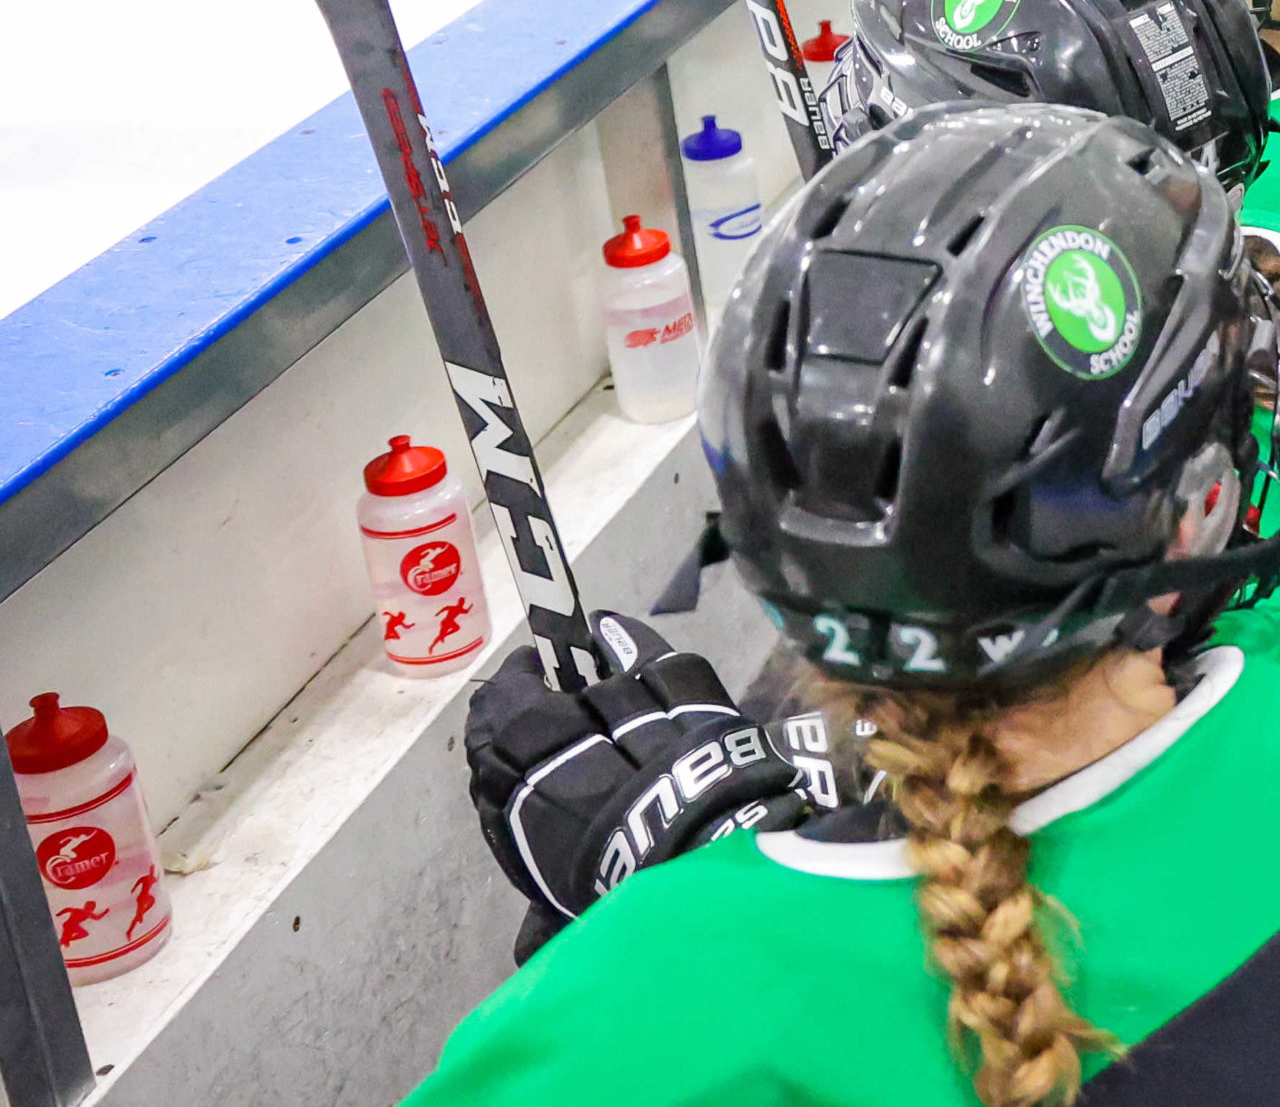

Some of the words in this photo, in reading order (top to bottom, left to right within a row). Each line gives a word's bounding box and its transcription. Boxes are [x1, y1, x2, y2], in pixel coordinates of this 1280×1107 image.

[935, 16, 982, 50] SCHOOL
[1025, 230, 1112, 339] WINCHENDON
[1089, 309, 1142, 375] SCHOOL
[594, 726, 768, 897] BAUE
